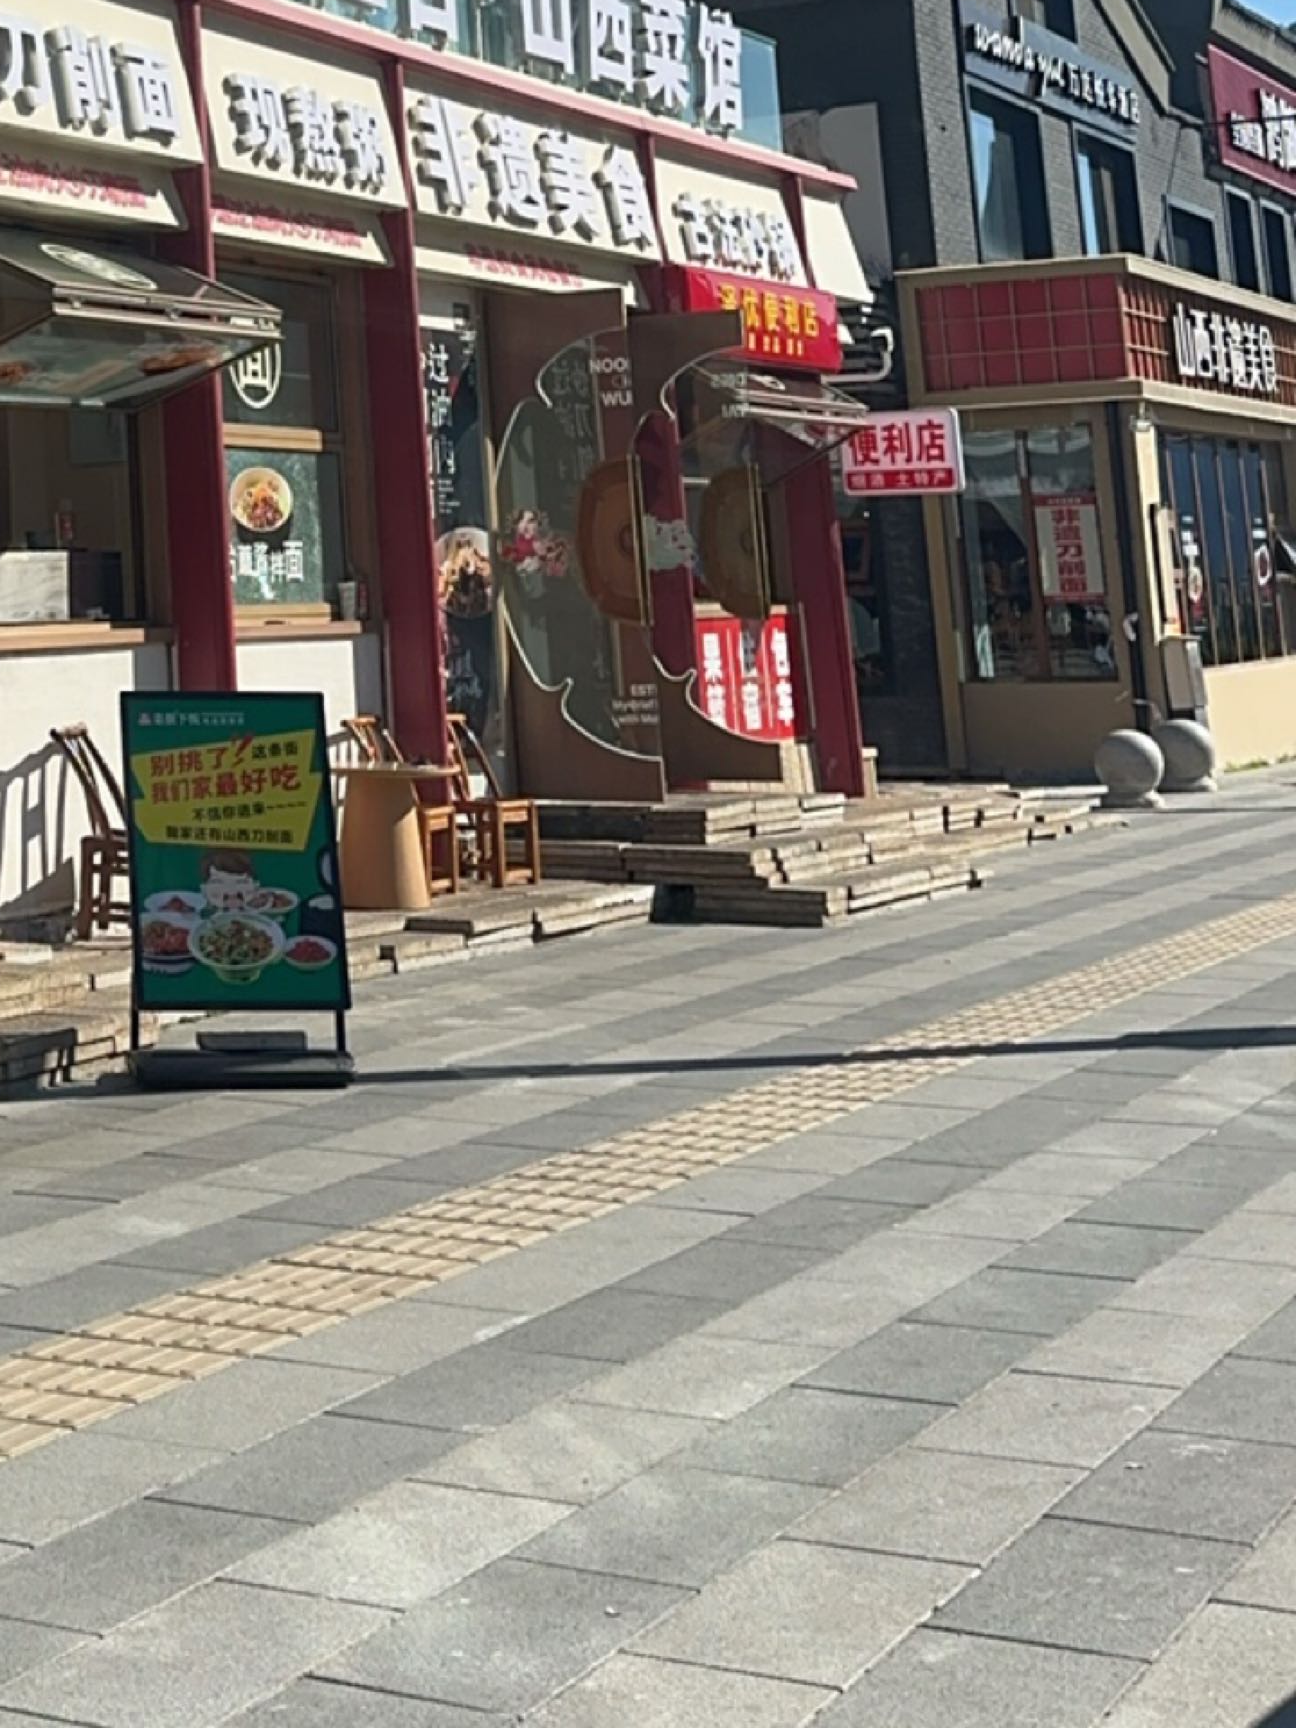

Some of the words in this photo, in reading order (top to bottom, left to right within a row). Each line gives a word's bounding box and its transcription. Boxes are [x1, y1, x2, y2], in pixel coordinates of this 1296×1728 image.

[409, 95, 658, 250] 非遗美食
[848, 420, 946, 466] 便利店
